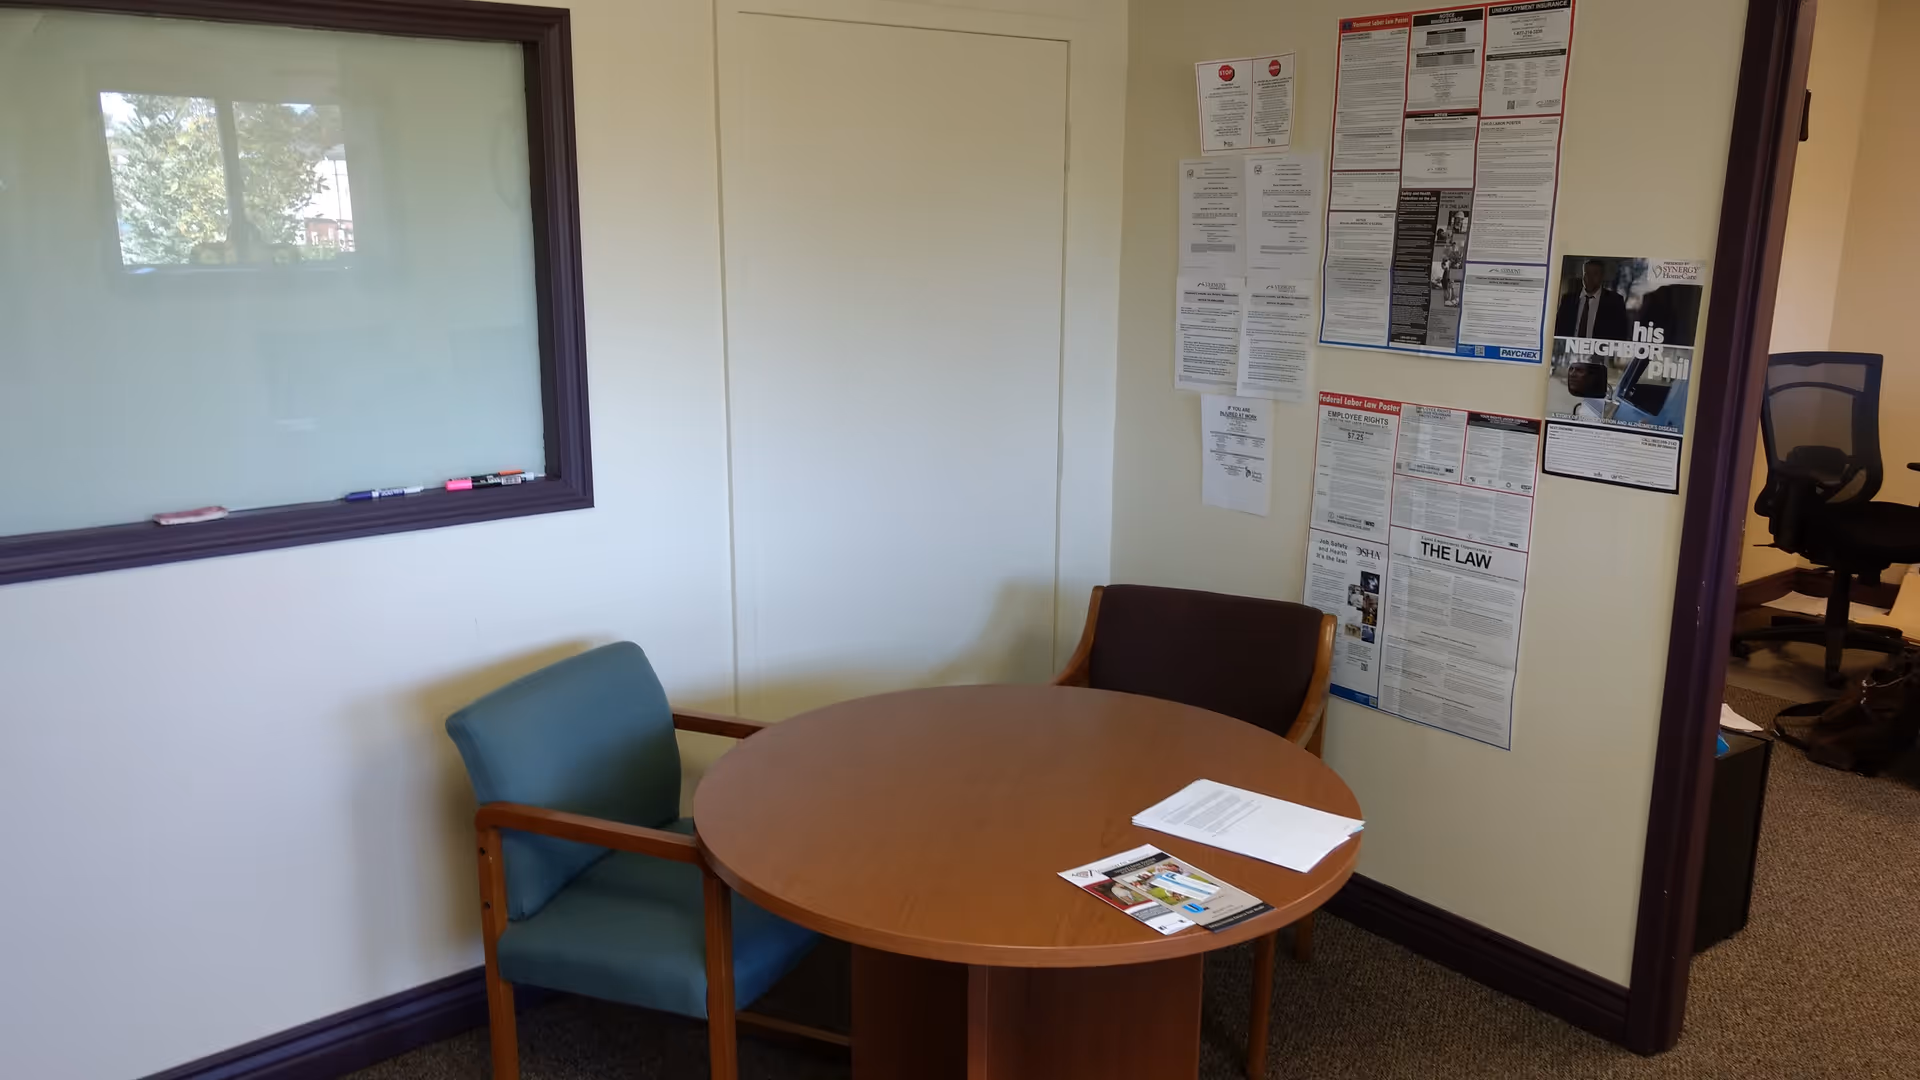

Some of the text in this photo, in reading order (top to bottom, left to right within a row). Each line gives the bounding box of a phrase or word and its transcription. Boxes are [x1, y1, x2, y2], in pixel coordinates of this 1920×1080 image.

[1491, 1, 1568, 13] UNEMPLOYMENT INSURANCE
[1662, 265, 1698, 274] SYNERGY
[1632, 321, 1664, 343] his
[1501, 349, 1538, 359] PAYCHEX
[1565, 339, 1664, 361] NEIGHBOR
[1648, 357, 1690, 380] phil
[1320, 394, 1400, 412] Federal Labor Law Poster
[1328, 410, 1362, 421] EMPLOYEE
[1363, 415, 1389, 426] RIGHTS
[1347, 431, 1364, 441] $7.25
[1329, 548, 1348, 556] Health
[1330, 540, 1348, 550] Safety
[1356, 546, 1381, 560] OSHA
[1420, 541, 1451, 561] THE
[1455, 549, 1492, 569] LAW
